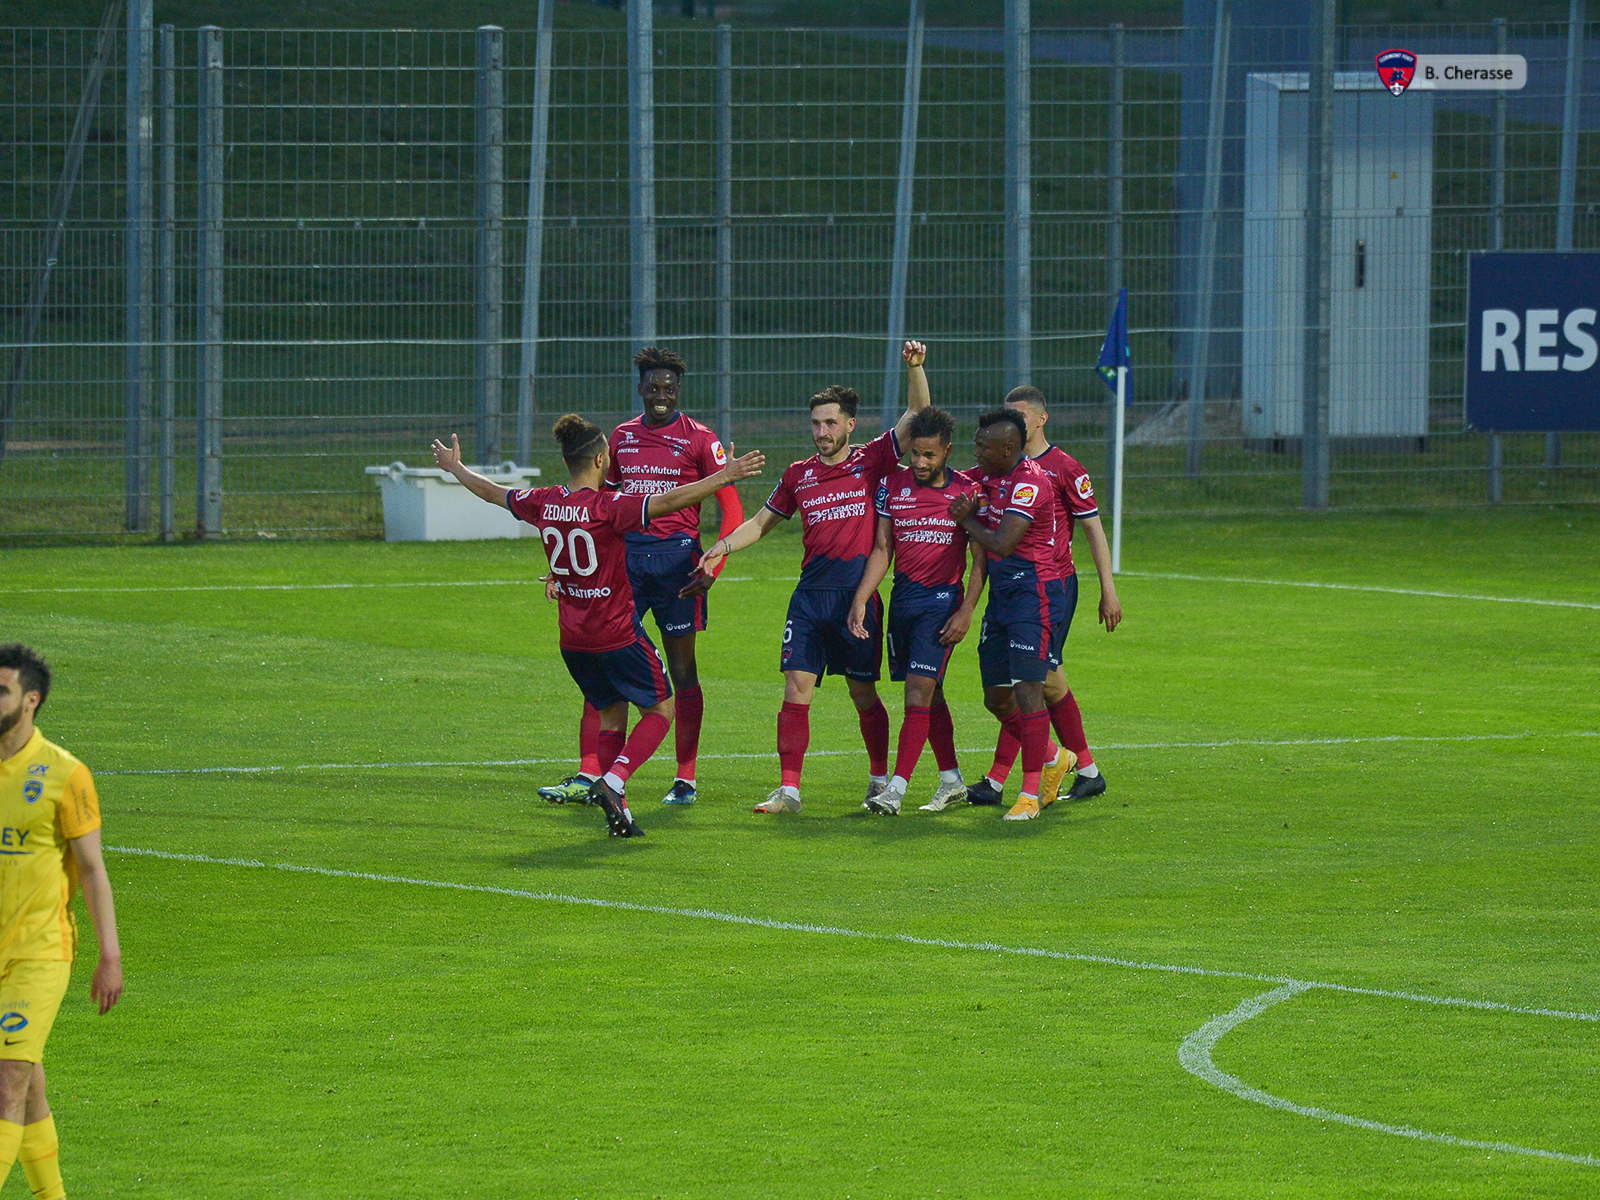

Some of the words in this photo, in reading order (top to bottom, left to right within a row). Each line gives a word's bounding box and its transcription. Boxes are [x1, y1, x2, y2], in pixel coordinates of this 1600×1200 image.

[1481, 308, 1599, 372] RES
[620, 465, 640, 474] Crédit
[650, 465, 681, 476] Mutuel
[633, 479, 679, 489] CLERMONT
[802, 496, 827, 509] Crédit
[836, 488, 866, 501] Mutuel
[542, 503, 590, 523] ZEDADKA
[821, 502, 866, 517] CLERMONT
[821, 509, 866, 521] FERRAND
[894, 517, 918, 527] Crédit
[542, 526, 599, 577] 20
[568, 586, 612, 599] BATIPRO
[782, 619, 793, 644] 6
[917, 663, 937, 672] VEOLIA
